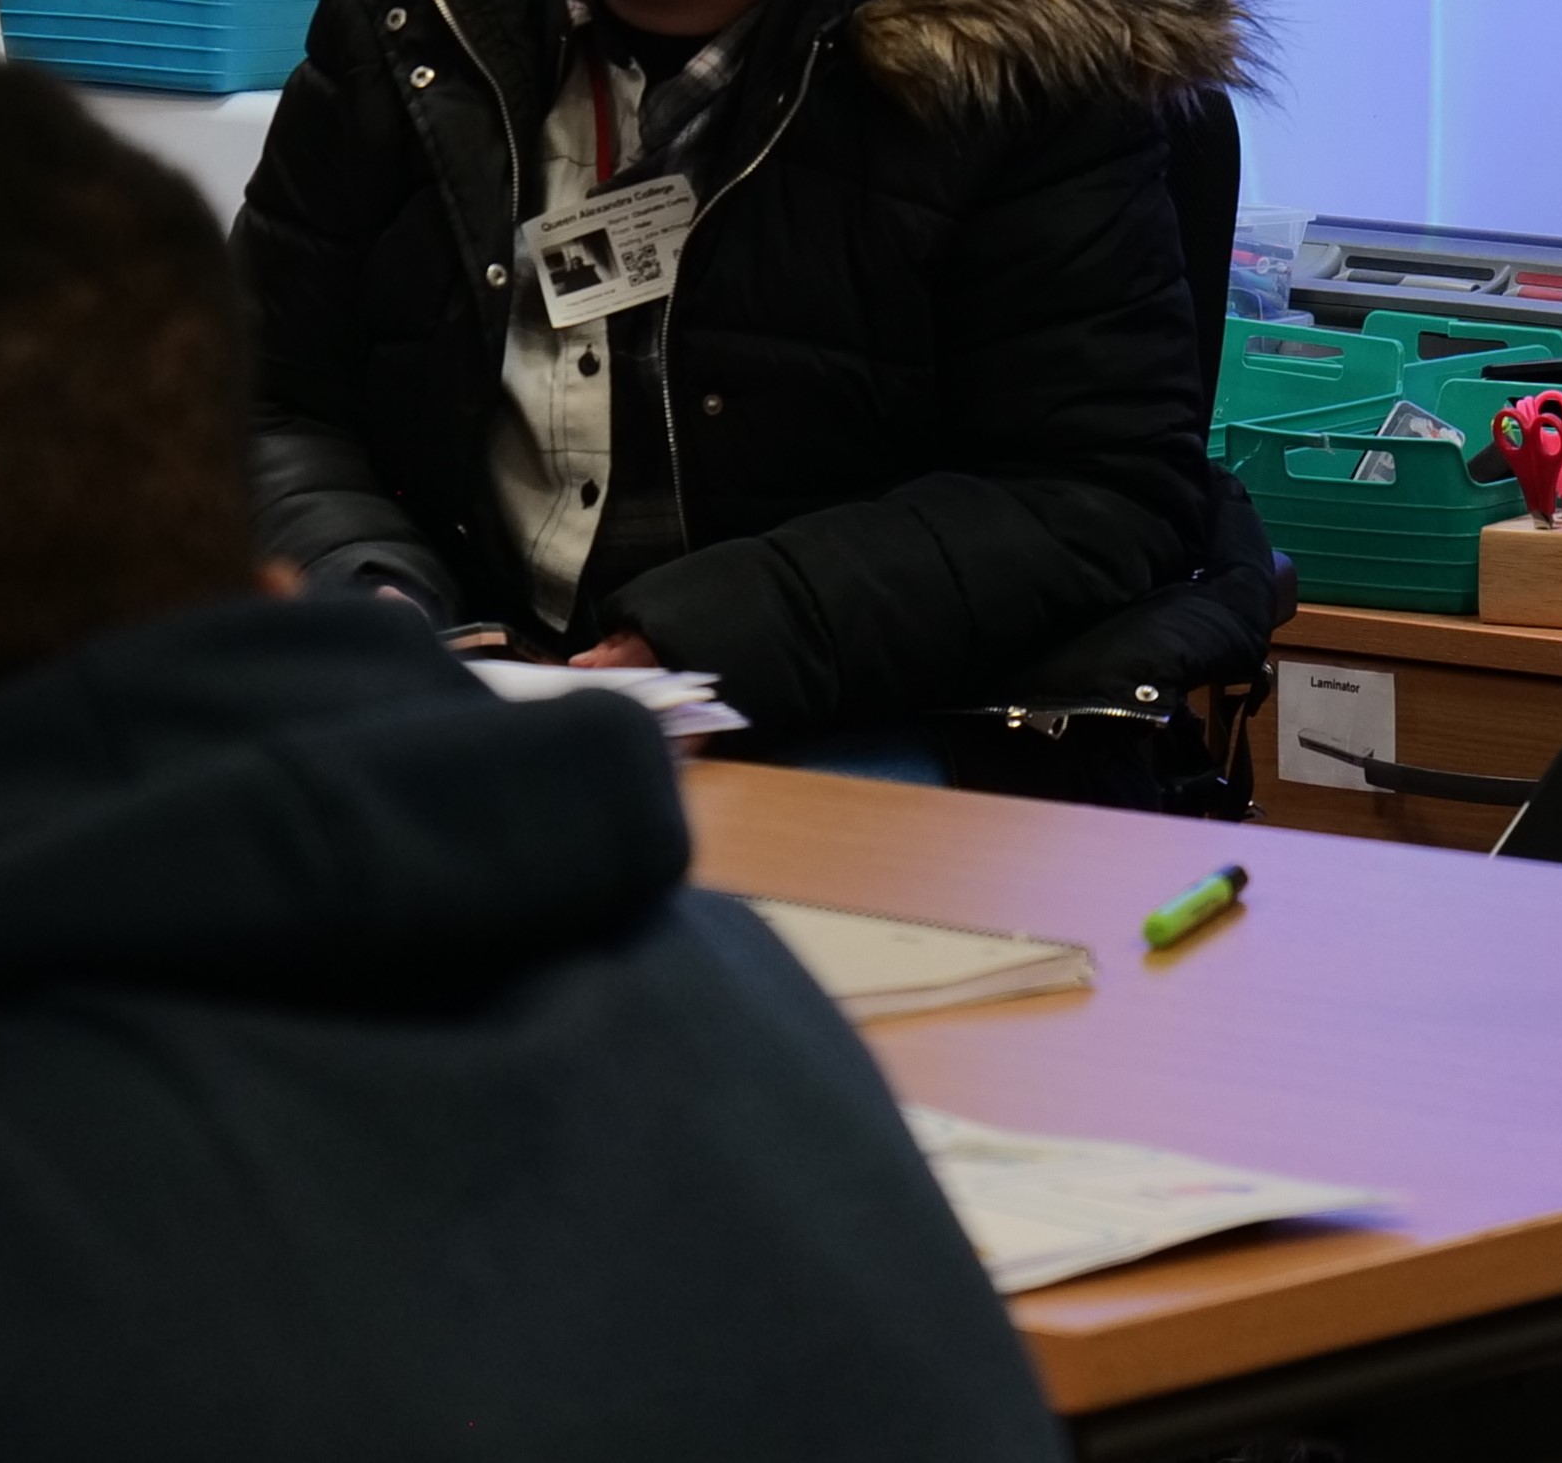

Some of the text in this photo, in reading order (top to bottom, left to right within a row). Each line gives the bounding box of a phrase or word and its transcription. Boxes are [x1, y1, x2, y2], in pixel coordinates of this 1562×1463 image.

[541, 184, 674, 232] Queen Alexandra College
[1310, 676, 1360, 693] Laminator
